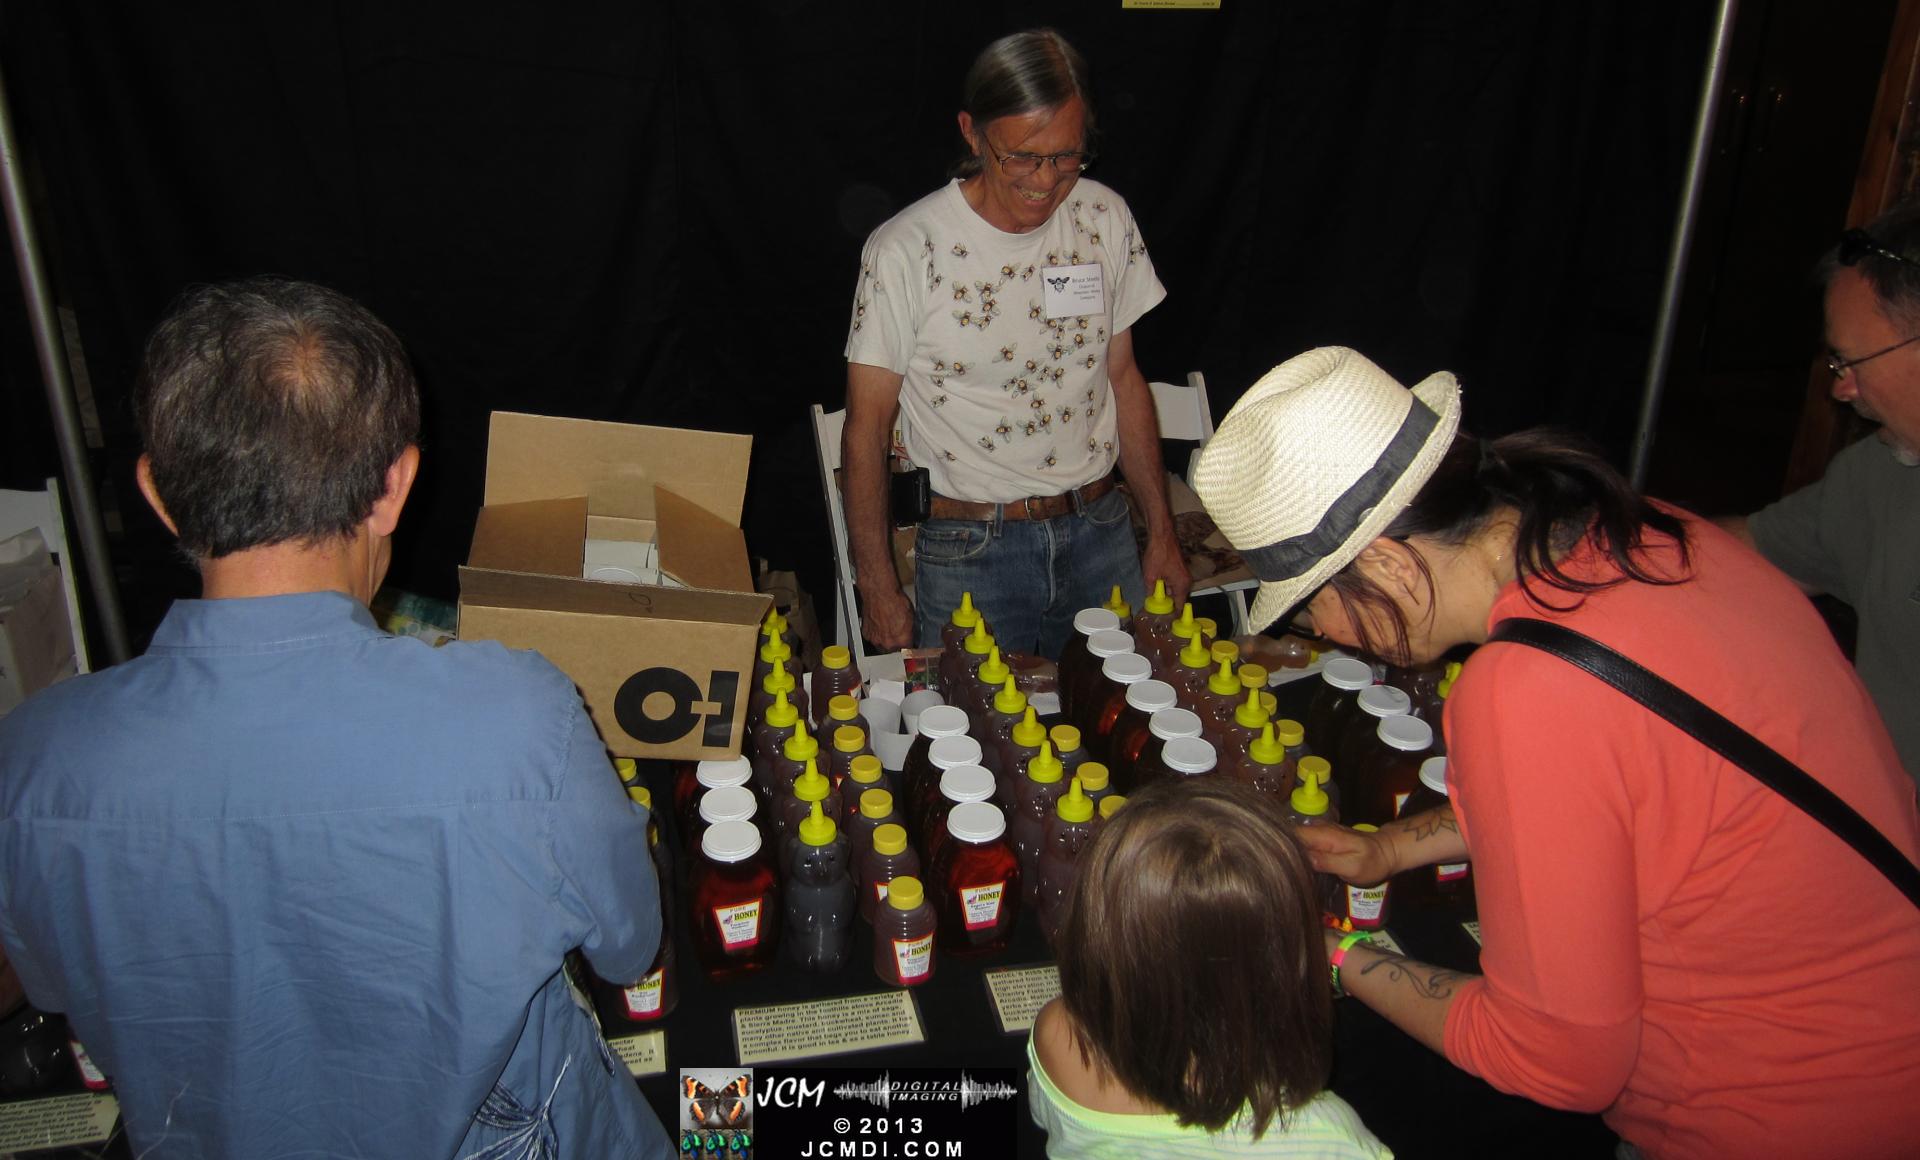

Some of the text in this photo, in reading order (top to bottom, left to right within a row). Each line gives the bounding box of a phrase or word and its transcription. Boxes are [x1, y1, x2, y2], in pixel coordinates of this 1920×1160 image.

[734, 909, 758, 921] HONEY
[739, 1008, 776, 1016] PREMIUM
[811, 1000, 843, 1009] gathered
[764, 1012, 795, 1021] growing
[819, 1005, 849, 1013] foothills
[875, 998, 903, 1006] Arcadia
[741, 1026, 784, 1036] eucalyptus,
[786, 1022, 819, 1030] mustard,
[821, 1016, 862, 1025] buckwheat,
[742, 1035, 763, 1043] many
[787, 1029, 809, 1037] native
[827, 1022, 864, 1031] cultivated
[750, 1039, 782, 1048] complex
[824, 1031, 842, 1039] begs
[744, 1046, 779, 1056] spoonful.
[798, 1041, 817, 1050] good
